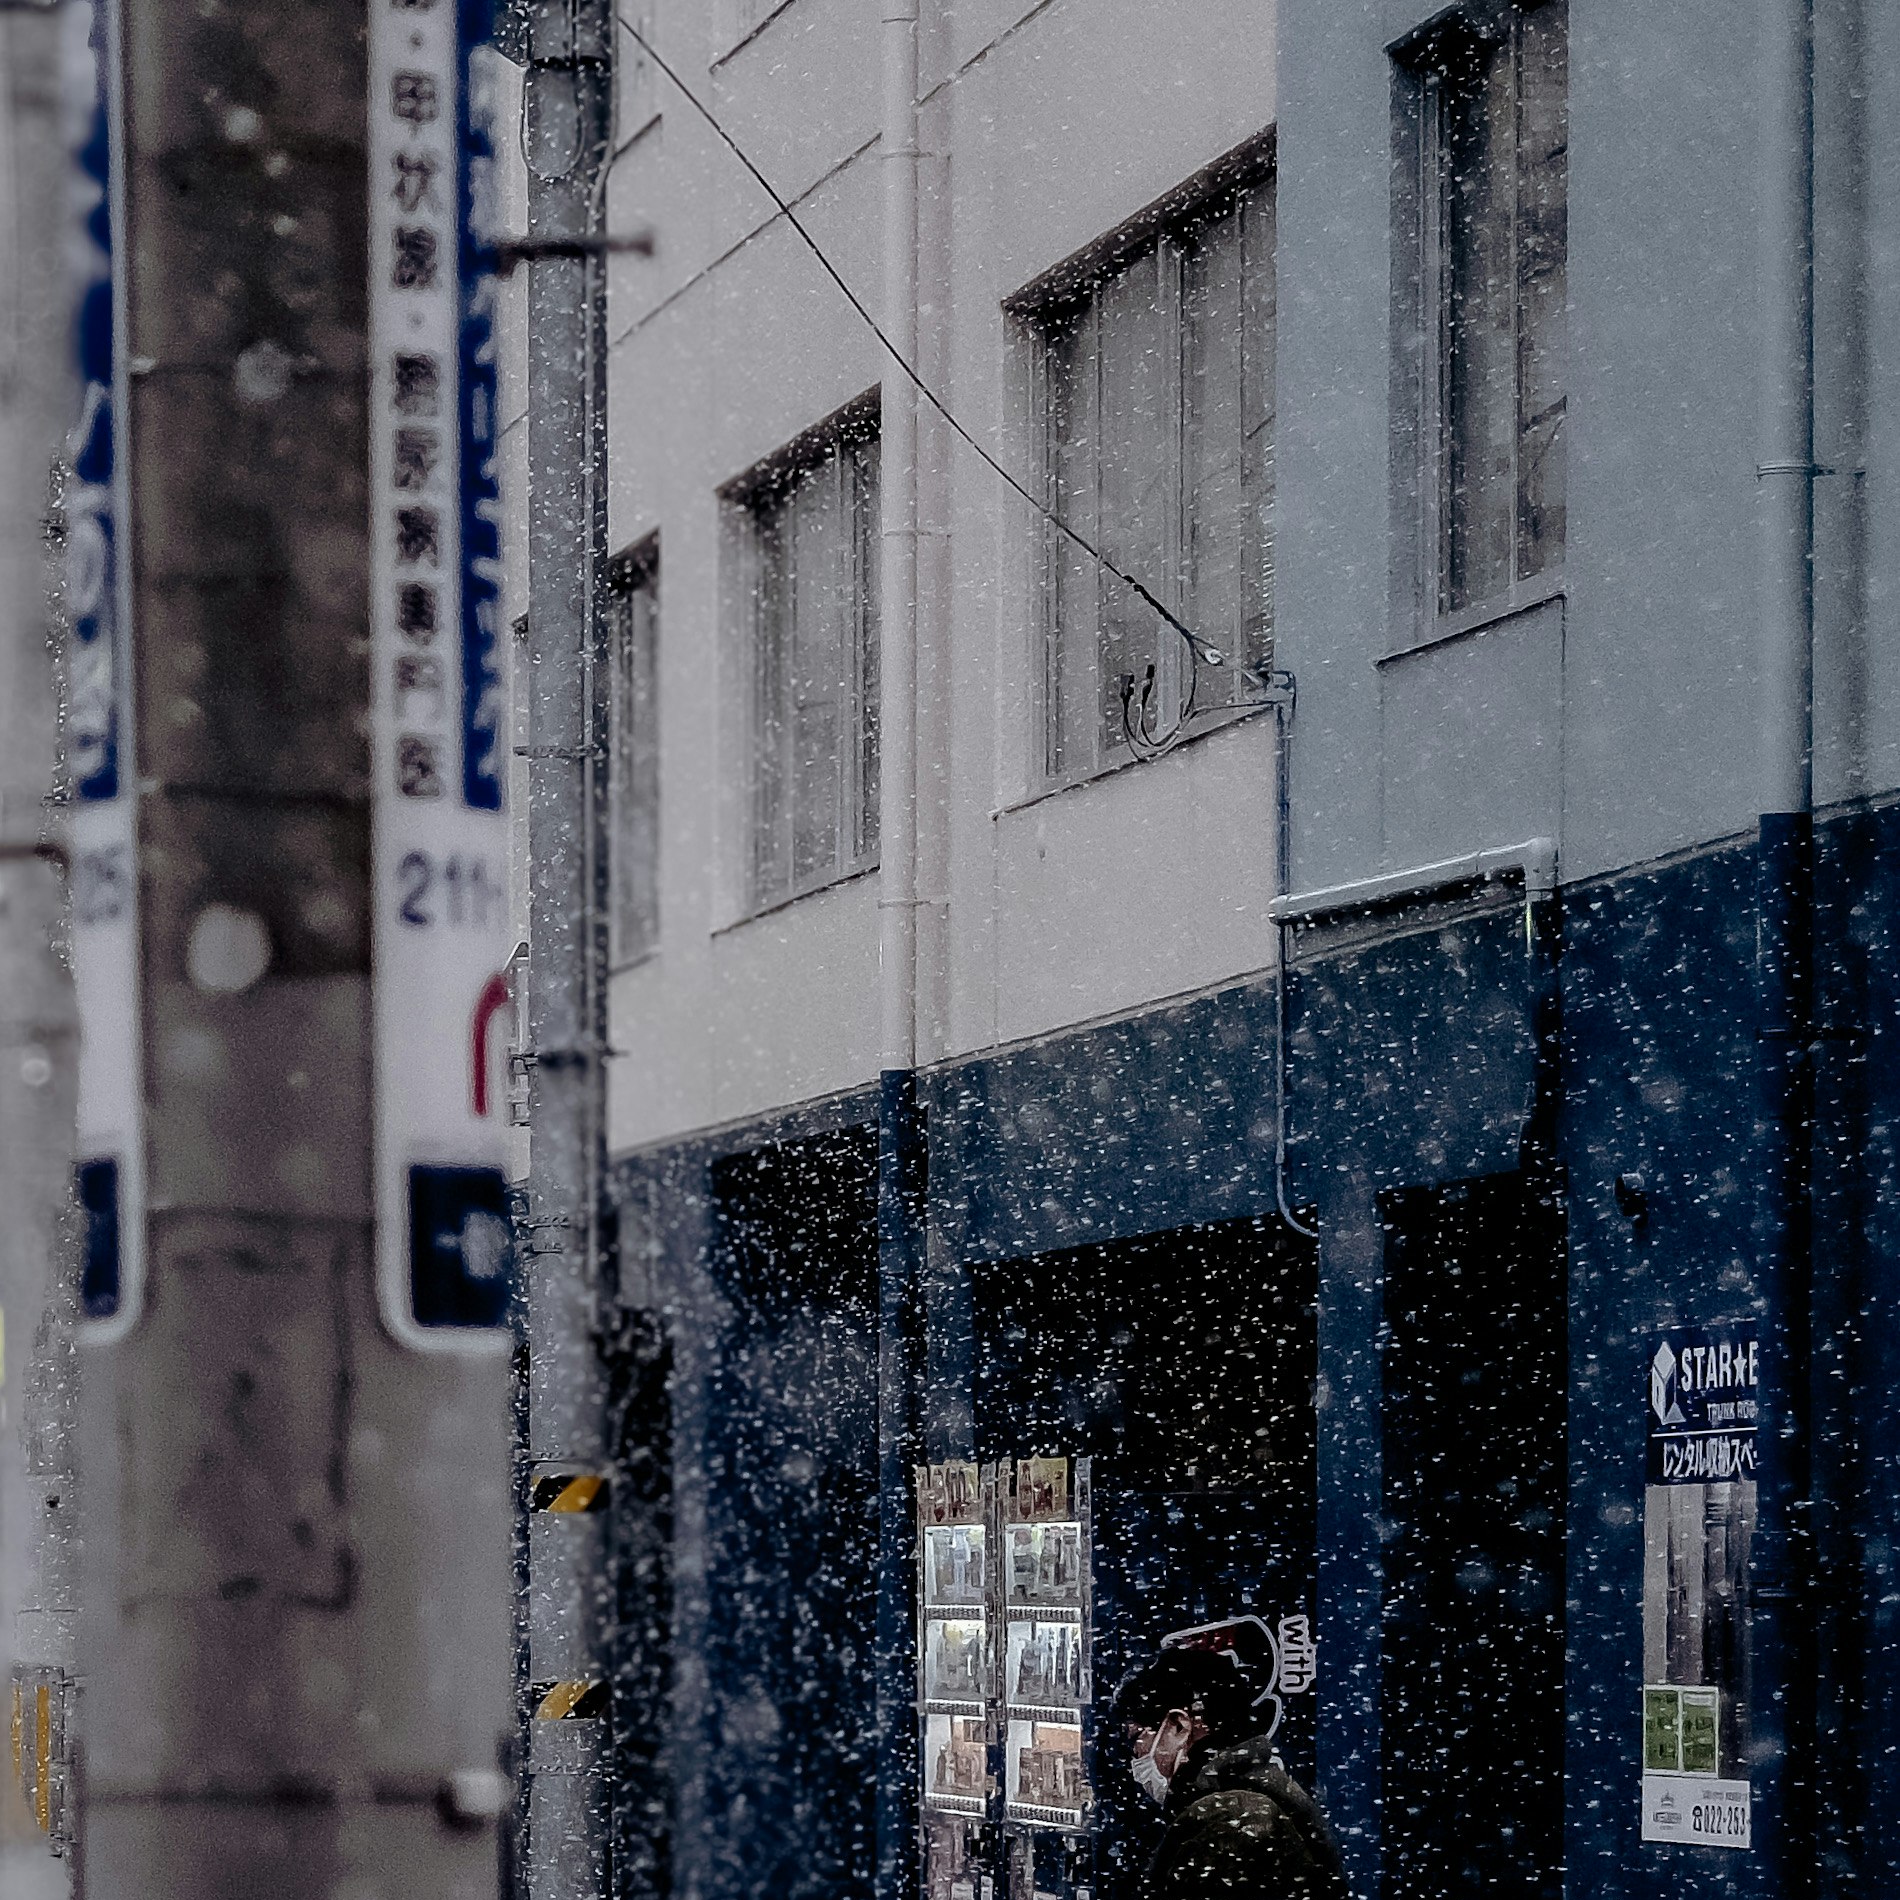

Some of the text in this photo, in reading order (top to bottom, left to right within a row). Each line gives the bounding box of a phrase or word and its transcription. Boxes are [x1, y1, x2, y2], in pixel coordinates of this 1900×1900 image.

[1663, 1436, 1758, 1478] レンタル収納スペ
[1283, 1618, 1313, 1688] with
